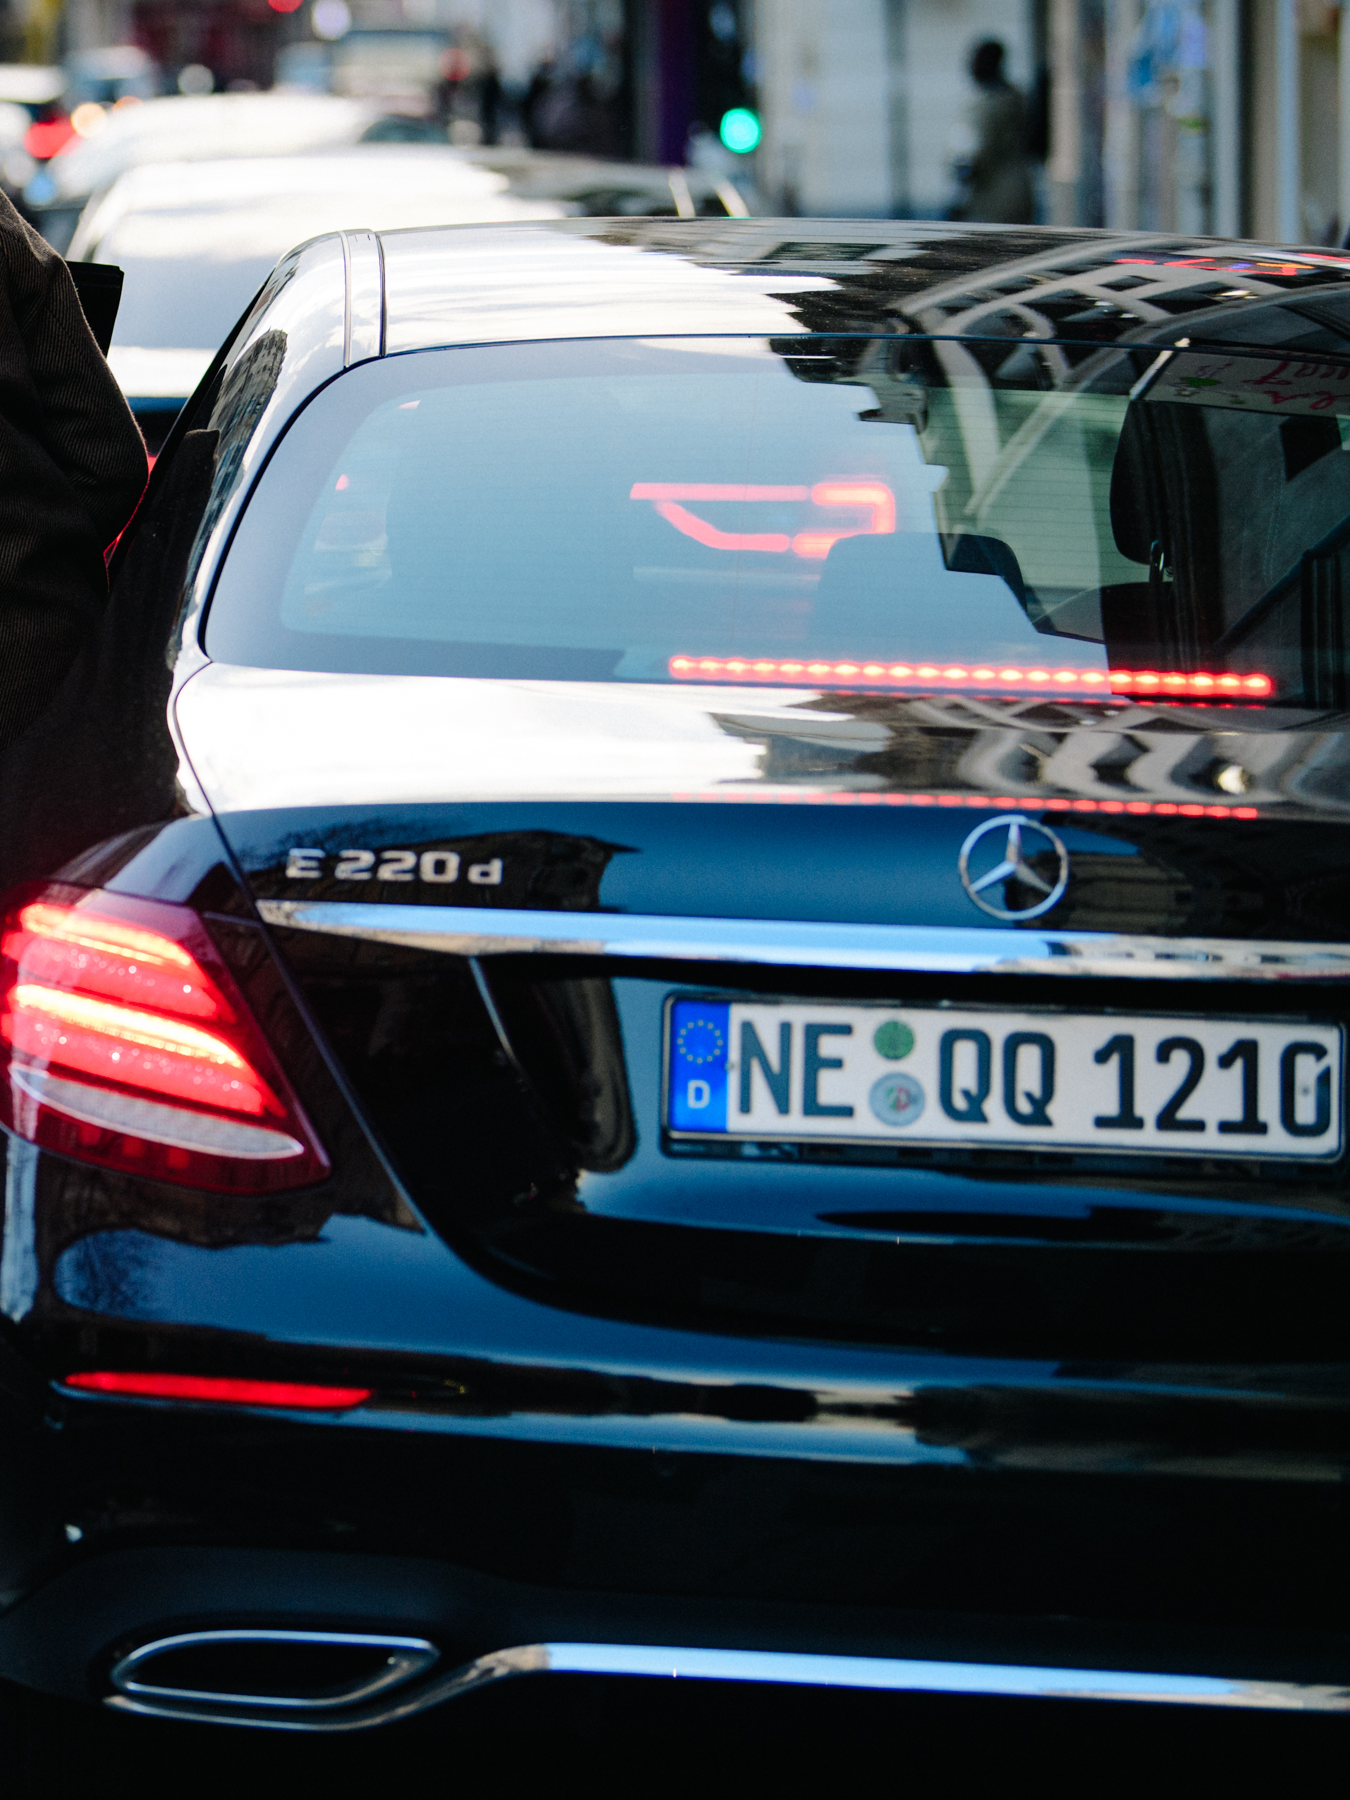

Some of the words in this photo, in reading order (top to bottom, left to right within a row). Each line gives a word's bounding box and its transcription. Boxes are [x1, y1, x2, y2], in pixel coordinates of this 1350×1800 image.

[286, 848, 326, 879] E
[687, 1079, 710, 1109] D
[739, 1021, 854, 1118] NE
[940, 1028, 1055, 1127] QQ
[1093, 1035, 1332, 1137] 1210
